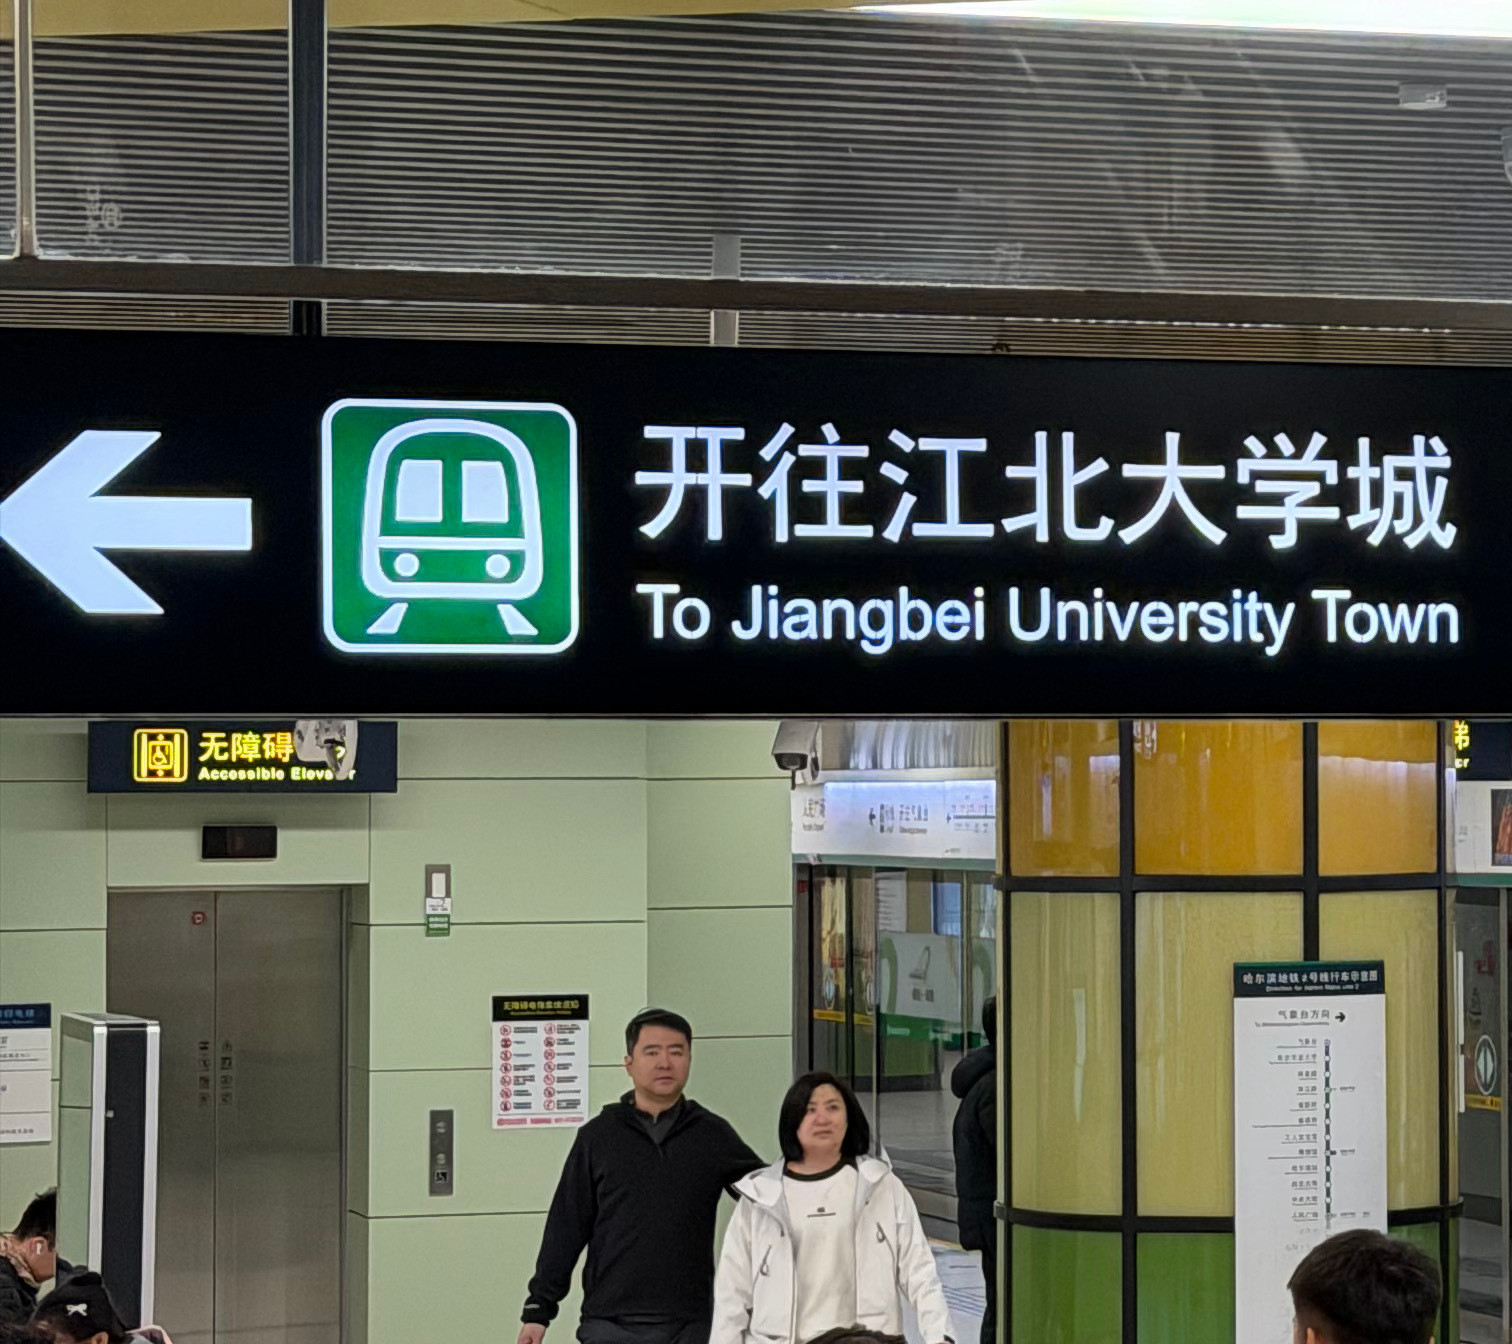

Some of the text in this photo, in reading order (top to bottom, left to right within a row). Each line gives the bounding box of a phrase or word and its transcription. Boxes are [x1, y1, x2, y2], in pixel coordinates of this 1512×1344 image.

[635, 422, 1457, 549] 开往江北大学城
[636, 584, 1458, 656] To Jiangbei University Town
[198, 729, 345, 762] 无障碍
[198, 766, 285, 781] Accessible
